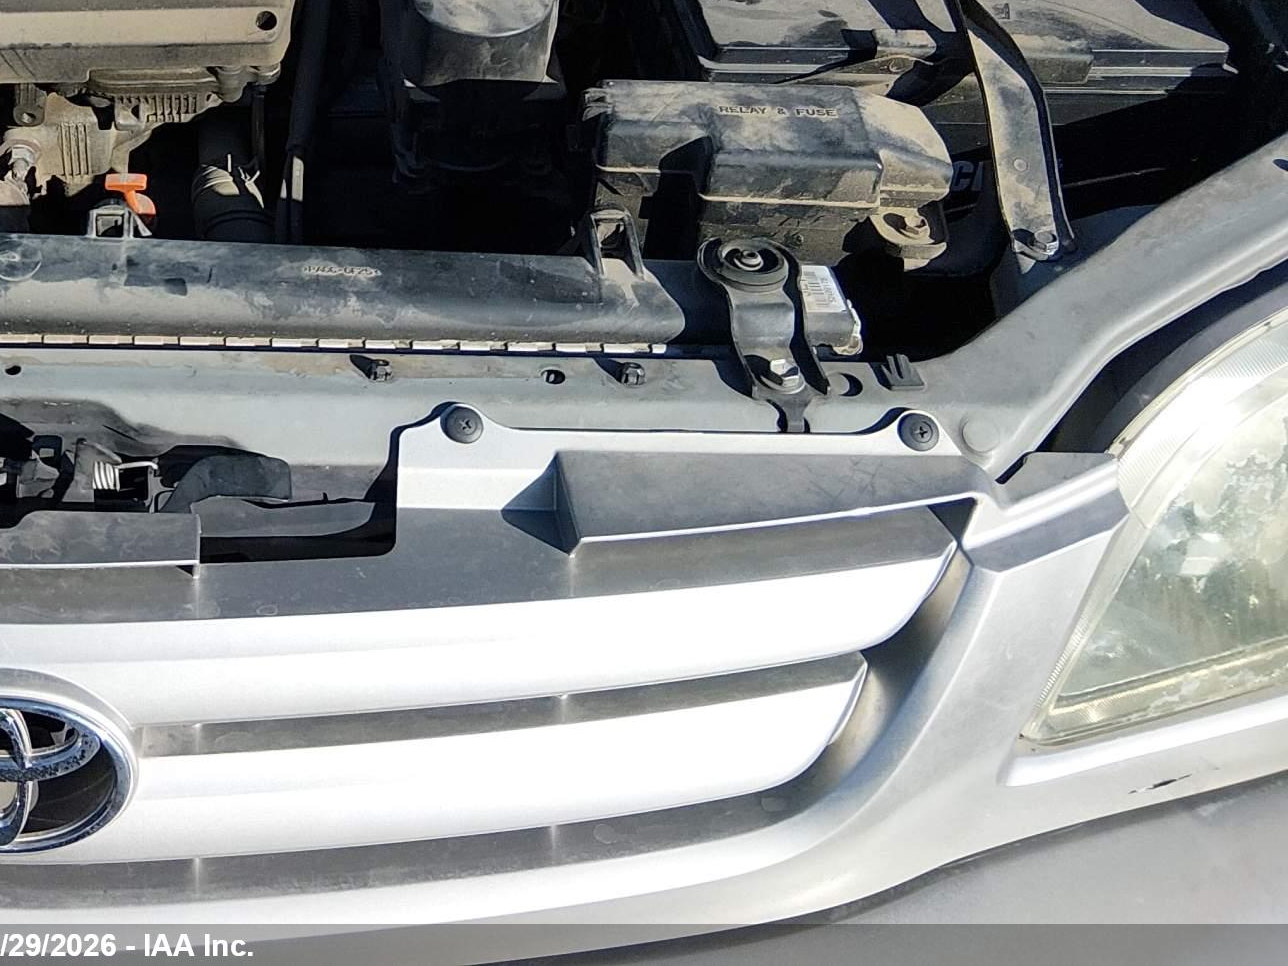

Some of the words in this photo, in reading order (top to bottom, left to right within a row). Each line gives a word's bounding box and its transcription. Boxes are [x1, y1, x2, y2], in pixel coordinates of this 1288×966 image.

[718, 105, 767, 115] RELAY
[776, 106, 787, 115] &
[795, 107, 838, 117] FUSE
